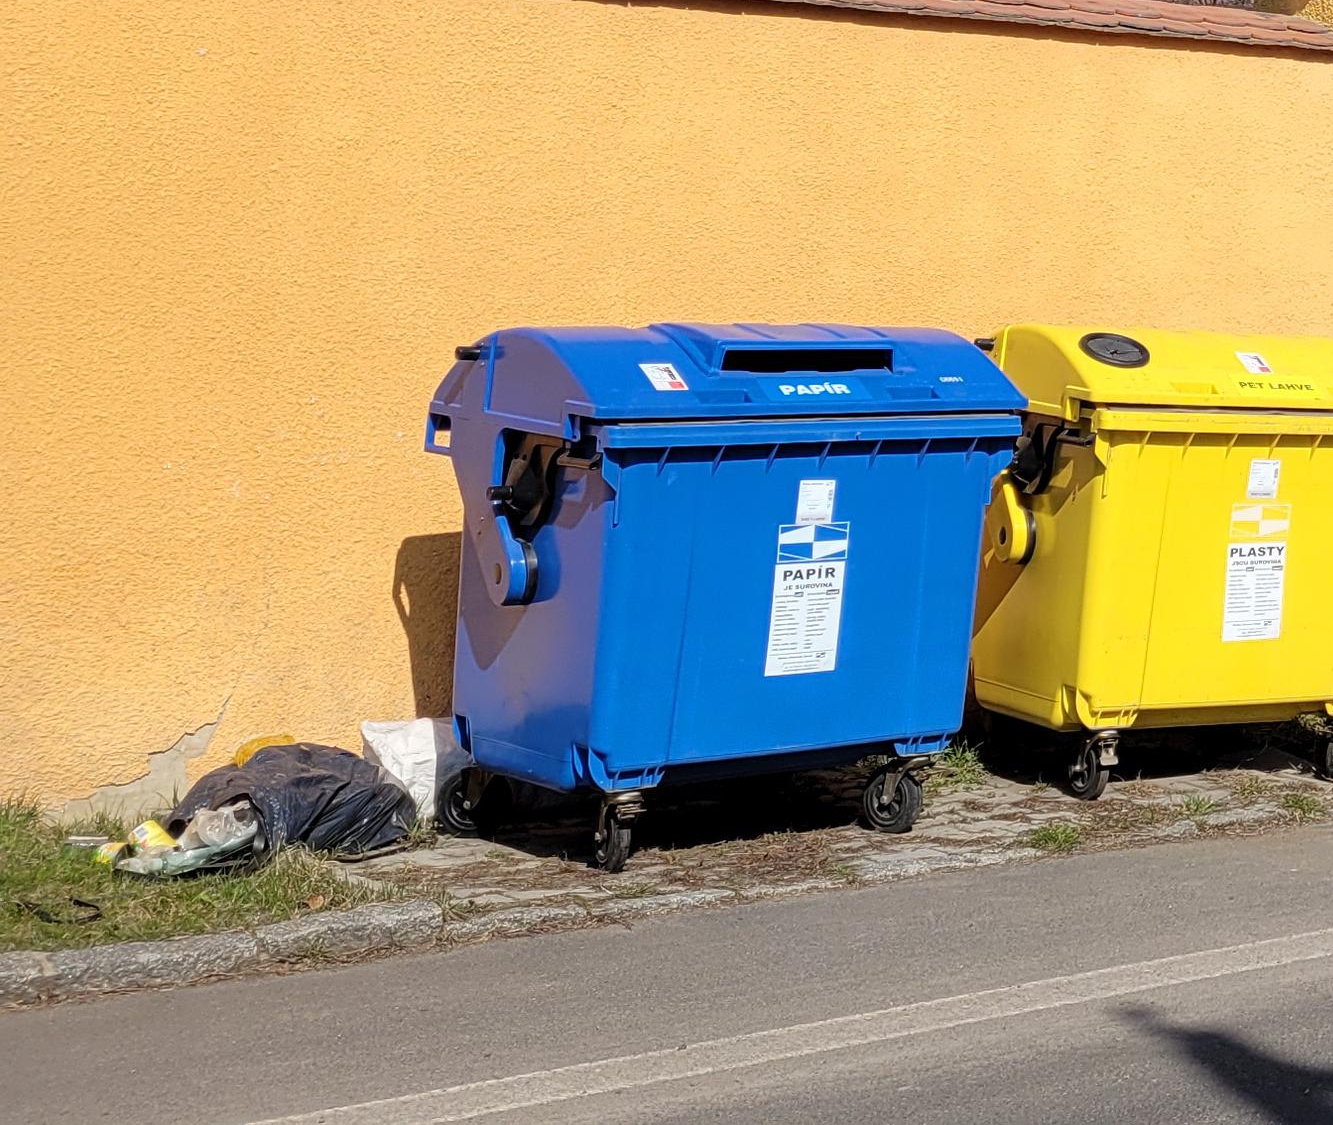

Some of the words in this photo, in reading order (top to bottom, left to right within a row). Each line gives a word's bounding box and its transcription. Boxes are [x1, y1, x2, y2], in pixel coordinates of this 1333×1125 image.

[778, 382, 851, 396] PAPÍR
[1239, 381, 1264, 389] PET
[1269, 382, 1314, 391] LAHVE
[1230, 546, 1285, 558] PLASTY
[783, 565, 836, 581] PAPÍR
[795, 582, 833, 590] SUROVINA
